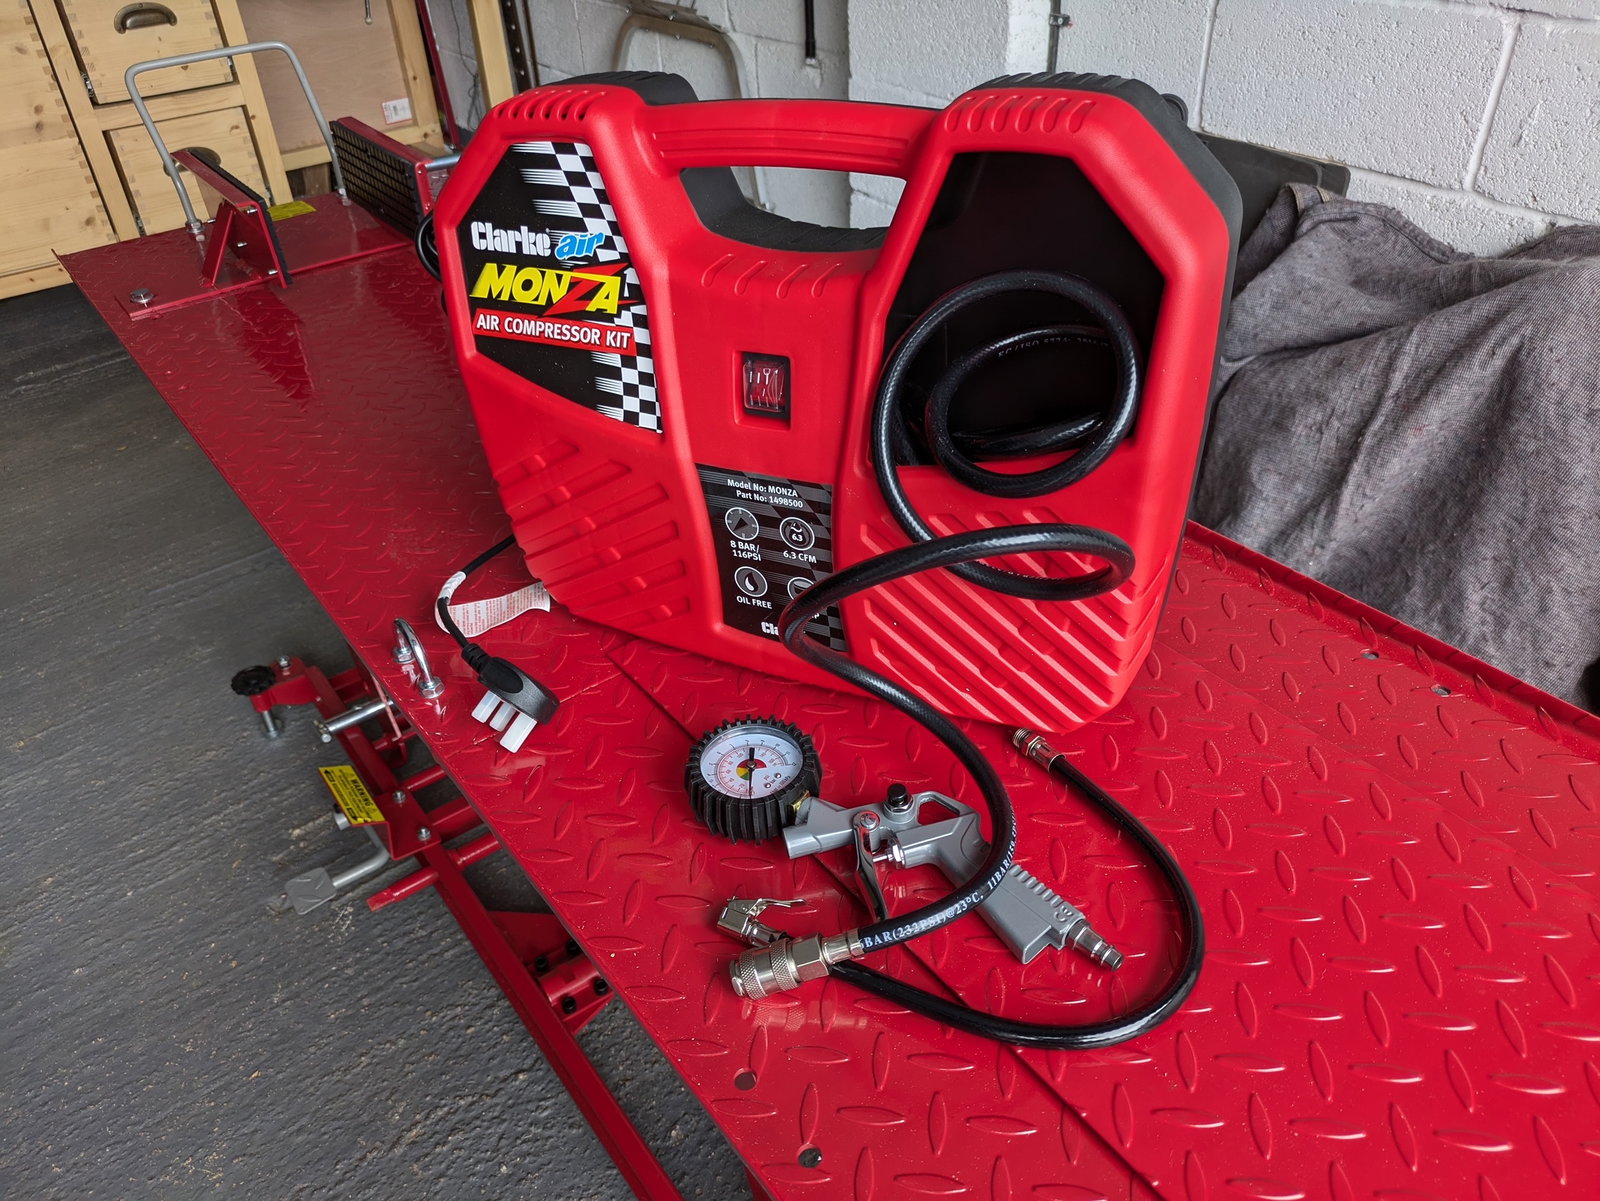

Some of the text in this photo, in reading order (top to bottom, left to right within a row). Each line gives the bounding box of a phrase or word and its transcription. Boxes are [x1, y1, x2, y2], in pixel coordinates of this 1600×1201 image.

[470, 221, 606, 260] Clarke air
[469, 262, 625, 317] MONZA
[476, 313, 631, 349] AIR COMPRESSOR KIT
[727, 479, 798, 497] Model No: MONZA
[736, 490, 803, 508] Part No: 1498500
[791, 533, 803, 542] 6.3
[730, 540, 760, 552] 8 BAR/
[732, 549, 761, 561] 116PSI
[783, 550, 817, 564] 6.3 CFM
[736, 595, 773, 610] OIL FREE
[761, 621, 779, 636] Cla
